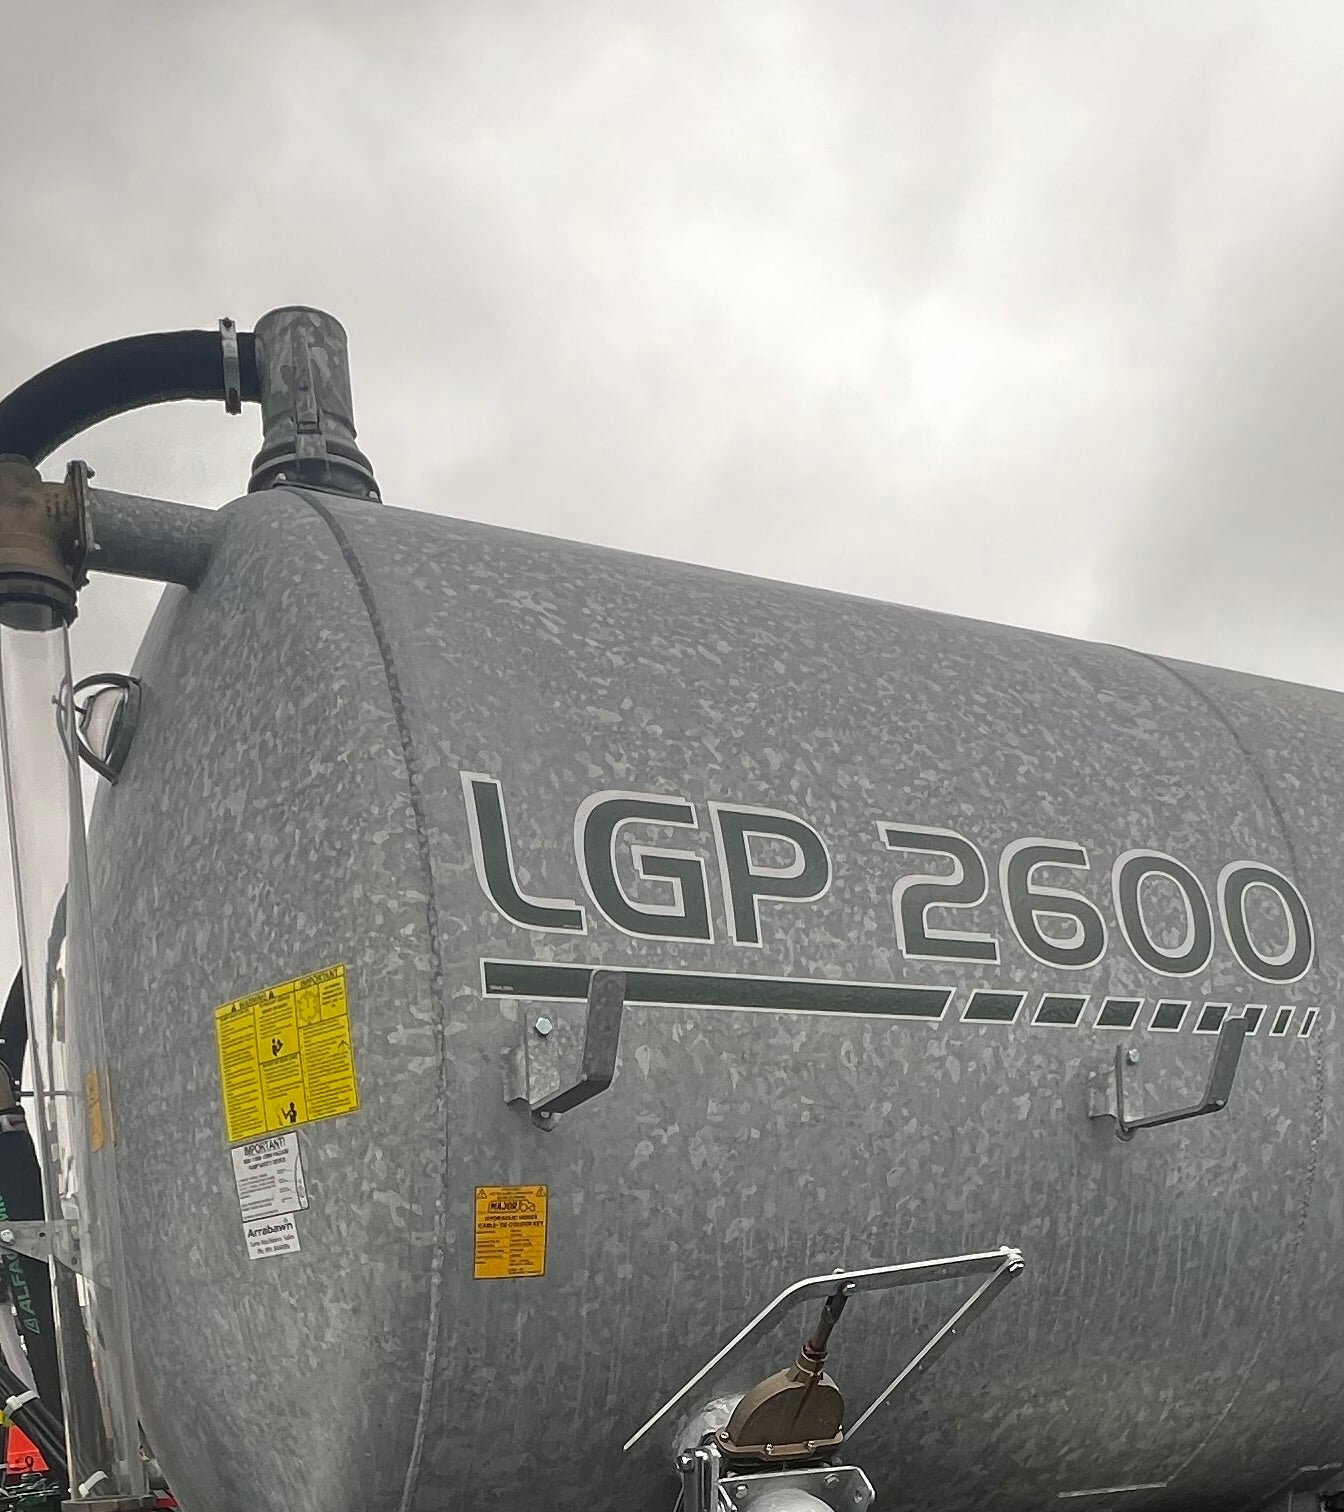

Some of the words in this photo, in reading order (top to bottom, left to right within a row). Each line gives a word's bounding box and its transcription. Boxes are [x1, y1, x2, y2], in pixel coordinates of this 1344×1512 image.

[460, 771, 832, 947] LGP
[876, 821, 1317, 985] 2600
[247, 1221, 294, 1239] Arrabawn
